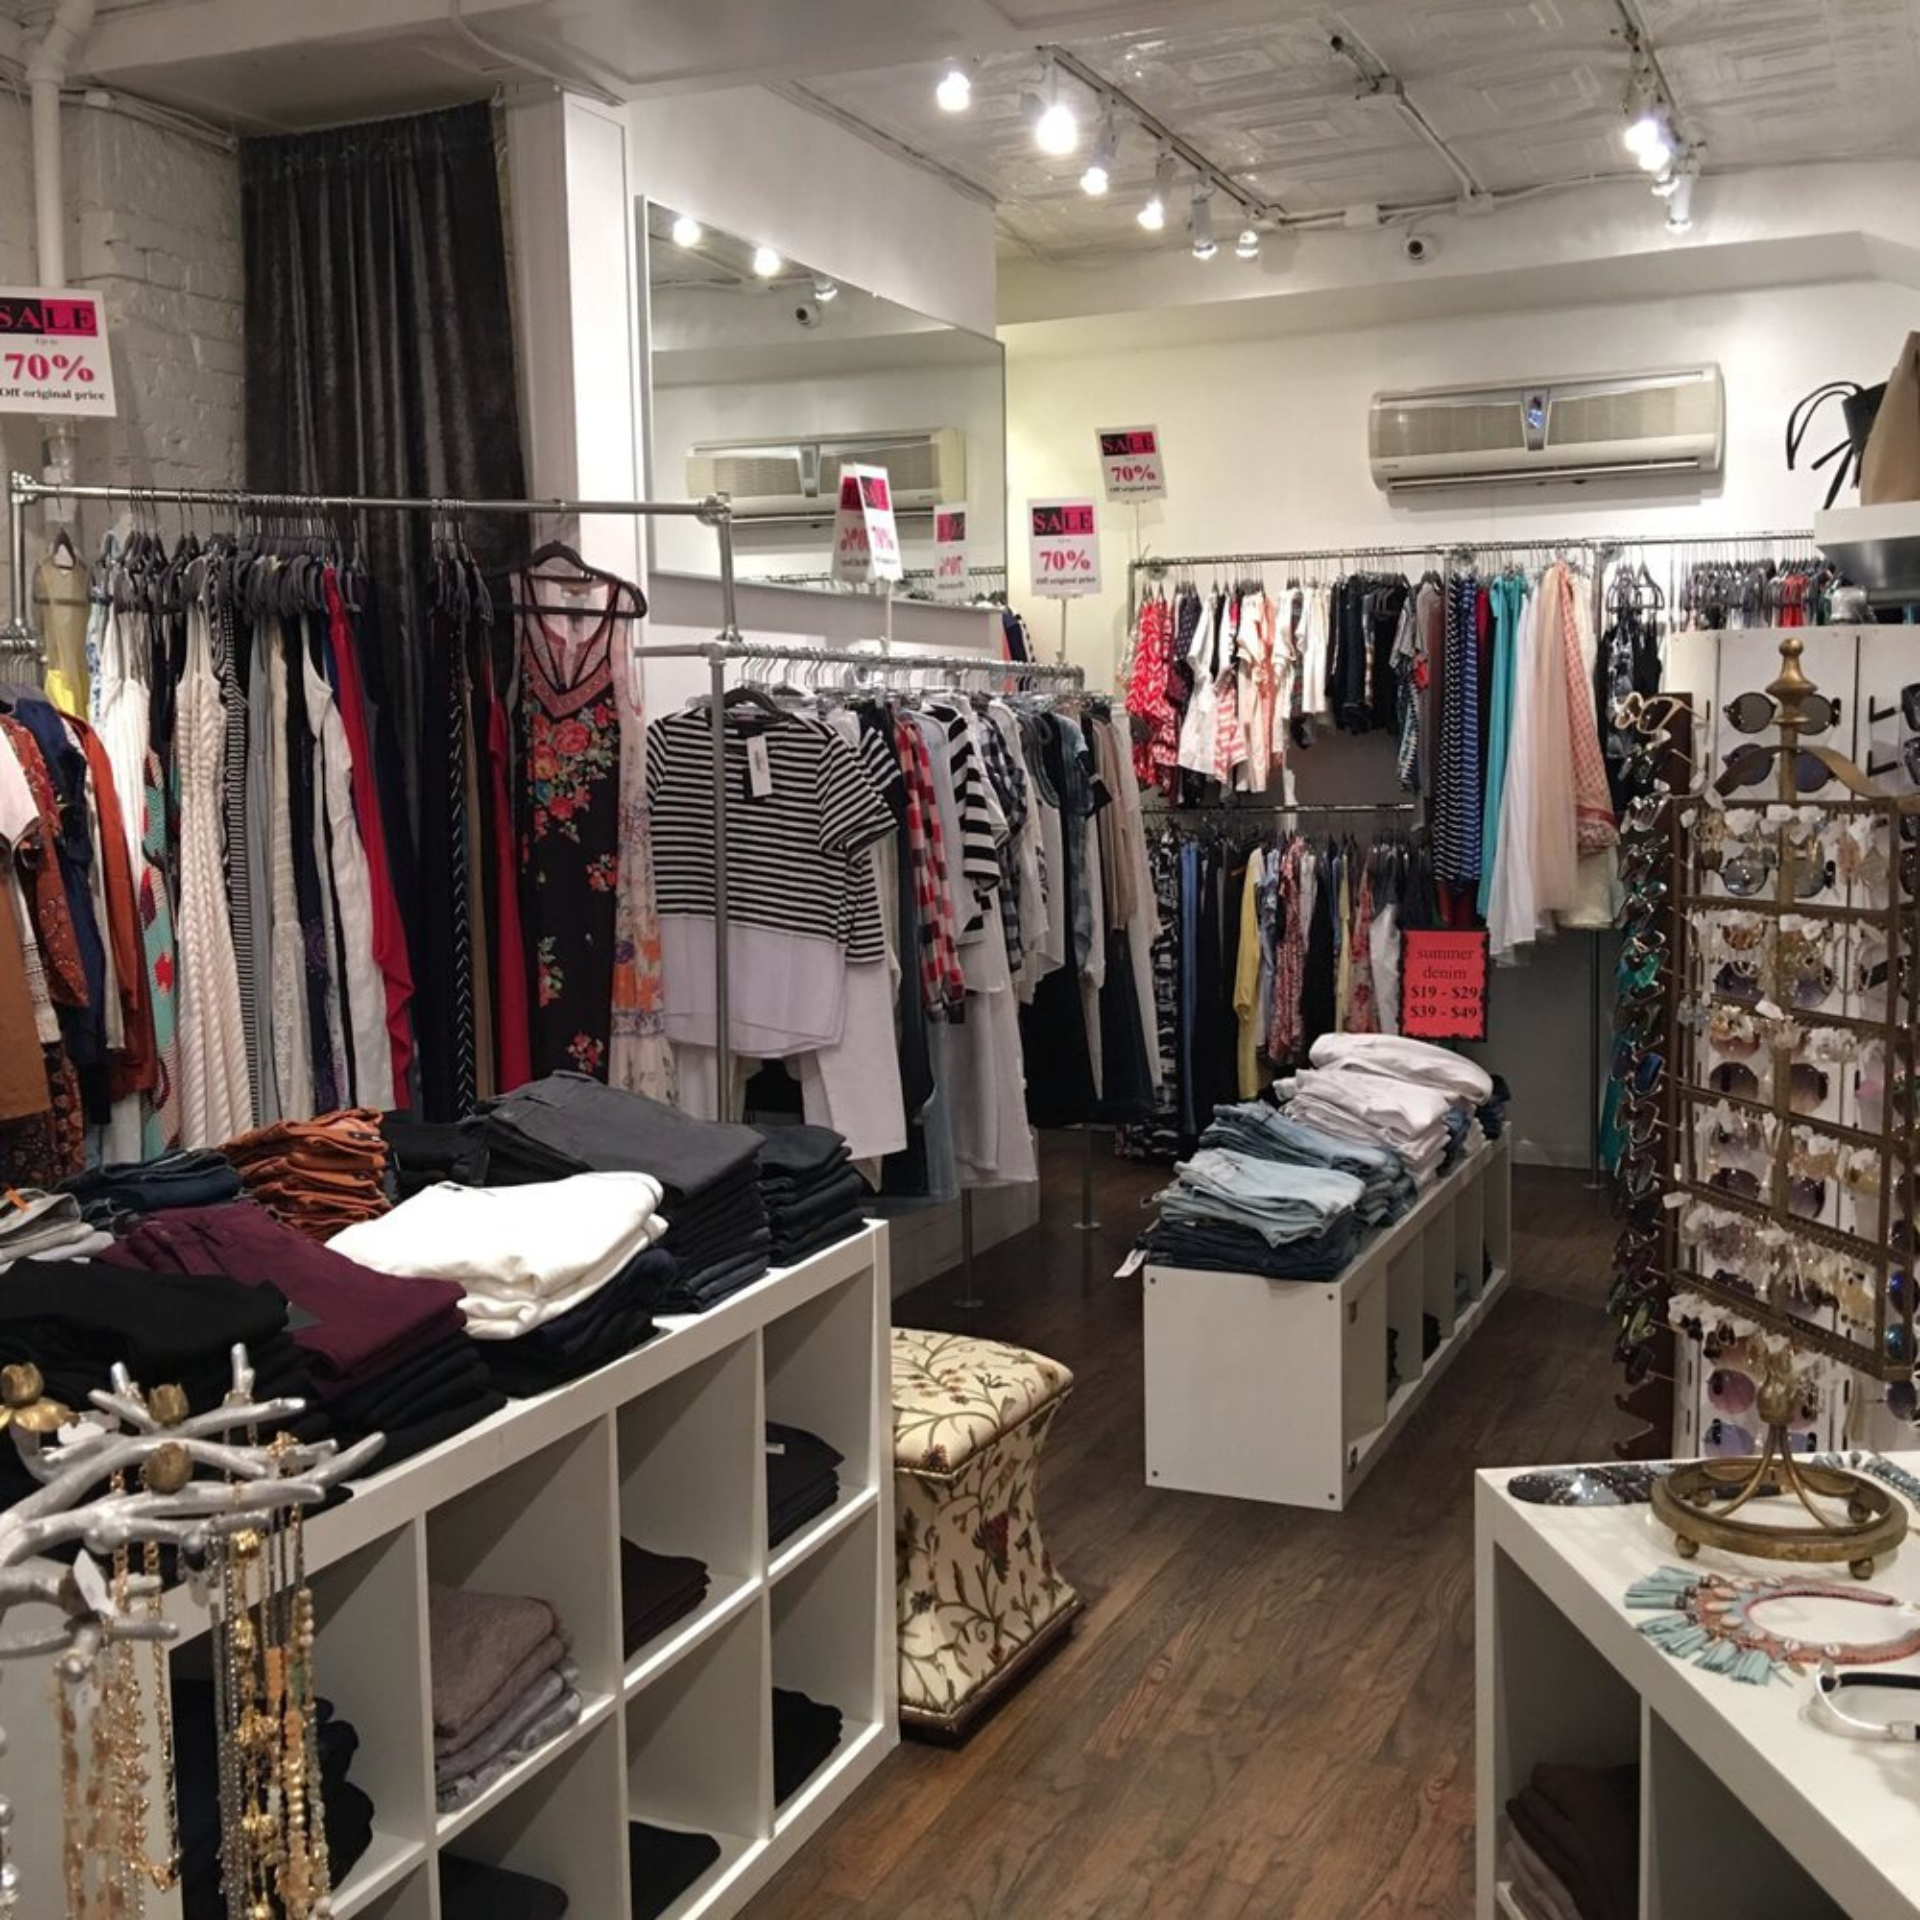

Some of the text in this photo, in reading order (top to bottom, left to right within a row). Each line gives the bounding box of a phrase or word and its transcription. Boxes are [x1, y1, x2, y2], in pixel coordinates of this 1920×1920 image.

[0, 305, 95, 332] SALE
[4, 352, 95, 382] 70%
[23, 388, 72, 401] original
[74, 390, 106, 402] price
[1102, 436, 1155, 454] SALE
[1111, 464, 1156, 482] 70%
[1033, 511, 1093, 533] SALE
[1040, 549, 1091, 572] 70%
[1417, 948, 1475, 960] summer
[1422, 965, 1467, 980] denim
[1411, 985, 1437, 999] $19
[1451, 986, 1478, 1000] $29
[1411, 1004, 1437, 1019] $39
[1451, 1005, 1478, 1019] $49
